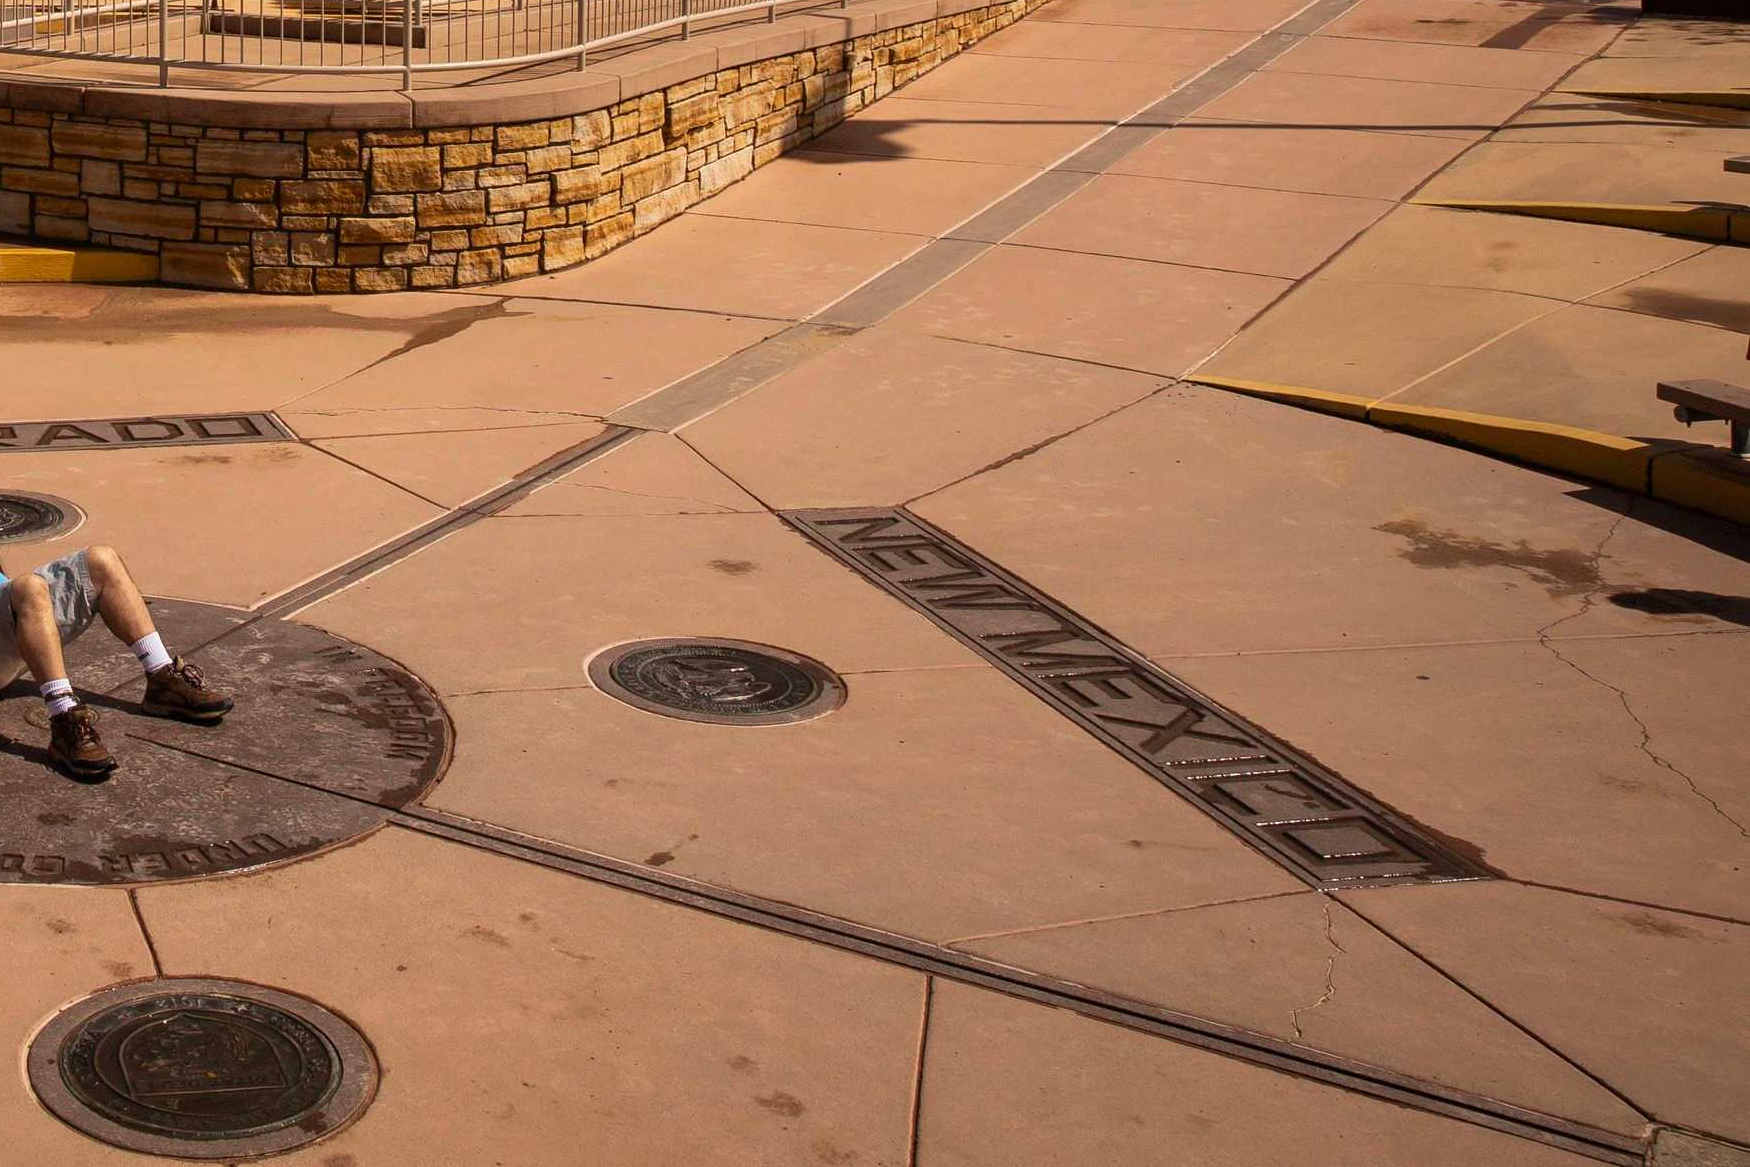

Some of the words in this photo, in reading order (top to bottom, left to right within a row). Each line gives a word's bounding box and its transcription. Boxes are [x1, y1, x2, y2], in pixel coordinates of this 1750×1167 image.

[814, 517, 1040, 610] NEW
[980, 630, 1431, 865] MEXICO
[99, 833, 287, 872] UNDER
